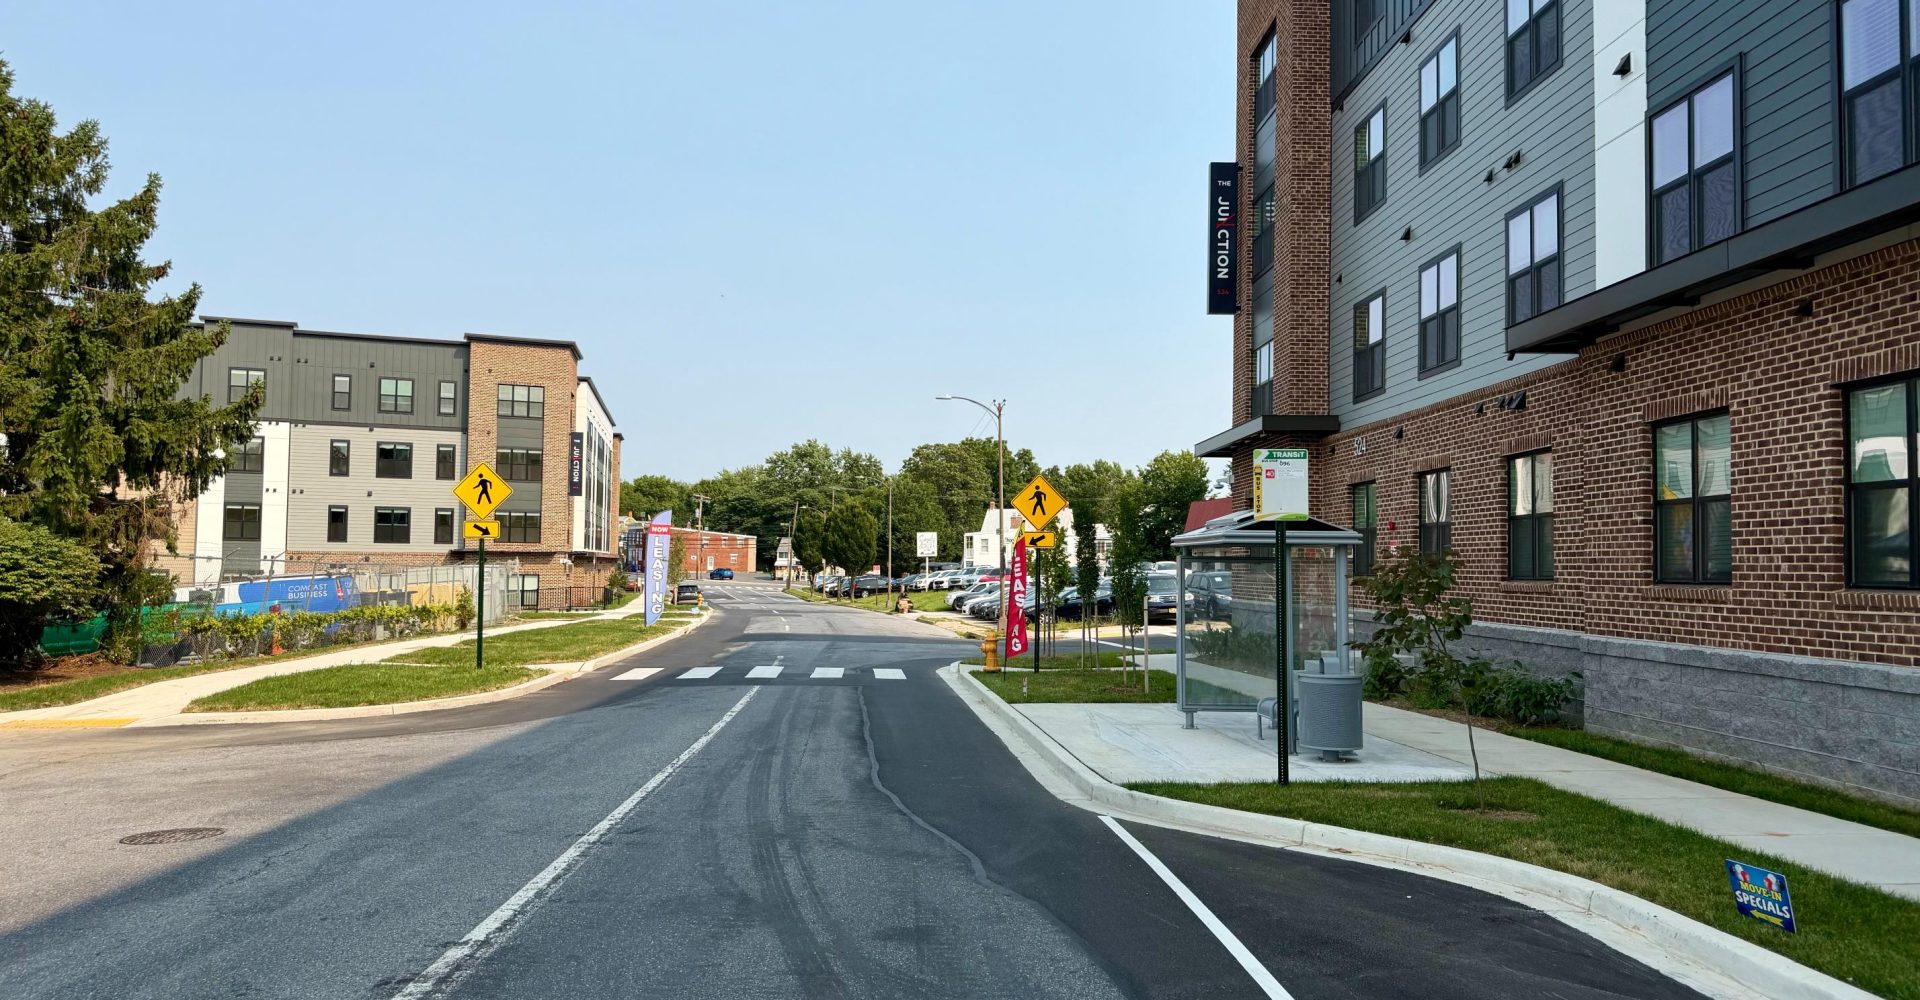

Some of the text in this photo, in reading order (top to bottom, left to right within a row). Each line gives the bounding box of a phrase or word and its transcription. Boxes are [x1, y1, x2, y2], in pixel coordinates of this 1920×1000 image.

[1216, 197, 1230, 278] JUNCTION
[1354, 437, 1366, 455] 524
[652, 536, 664, 614] LEASING
[1735, 891, 1790, 918] SPECIALS
[1740, 881, 1782, 901] MOVE-IN
